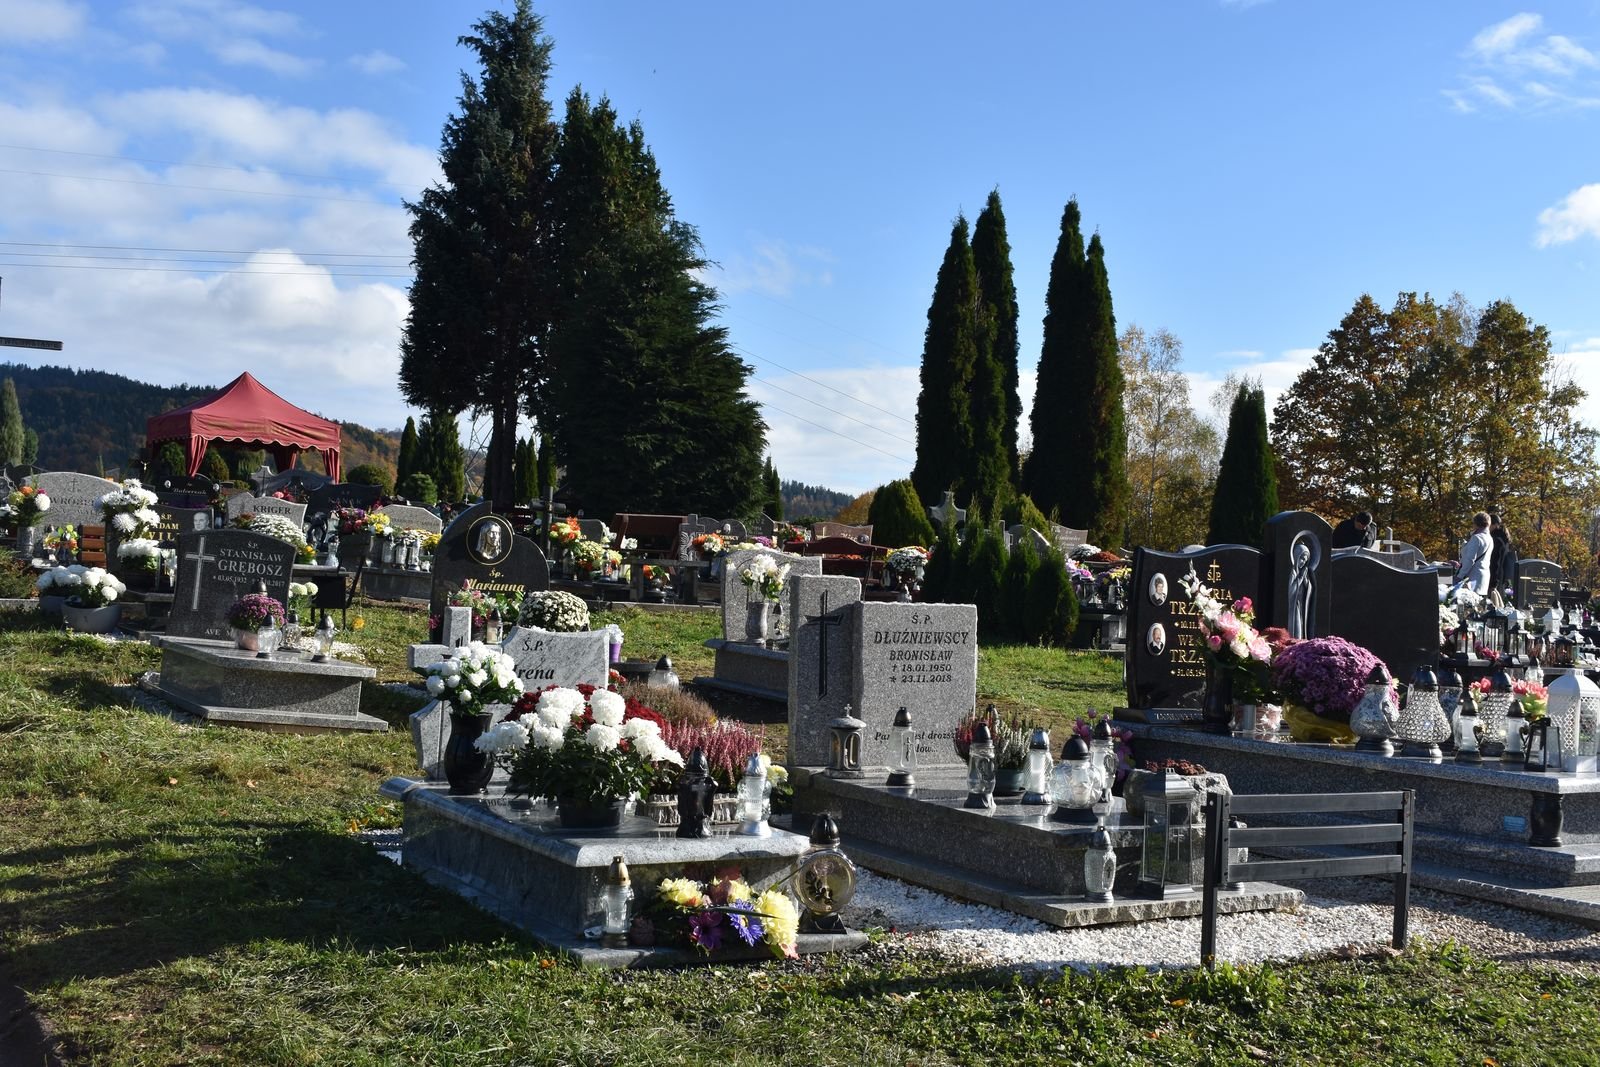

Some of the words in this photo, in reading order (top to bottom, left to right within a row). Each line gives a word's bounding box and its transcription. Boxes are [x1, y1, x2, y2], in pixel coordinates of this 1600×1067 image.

[253, 504, 292, 514] KRIGER
[220, 548, 284, 561] STANISŁAW
[217, 559, 283, 577] GRĘBOSZ
[889, 650, 953, 661] BRONISŁAW
[902, 664, 952, 672] 18.01.1950
